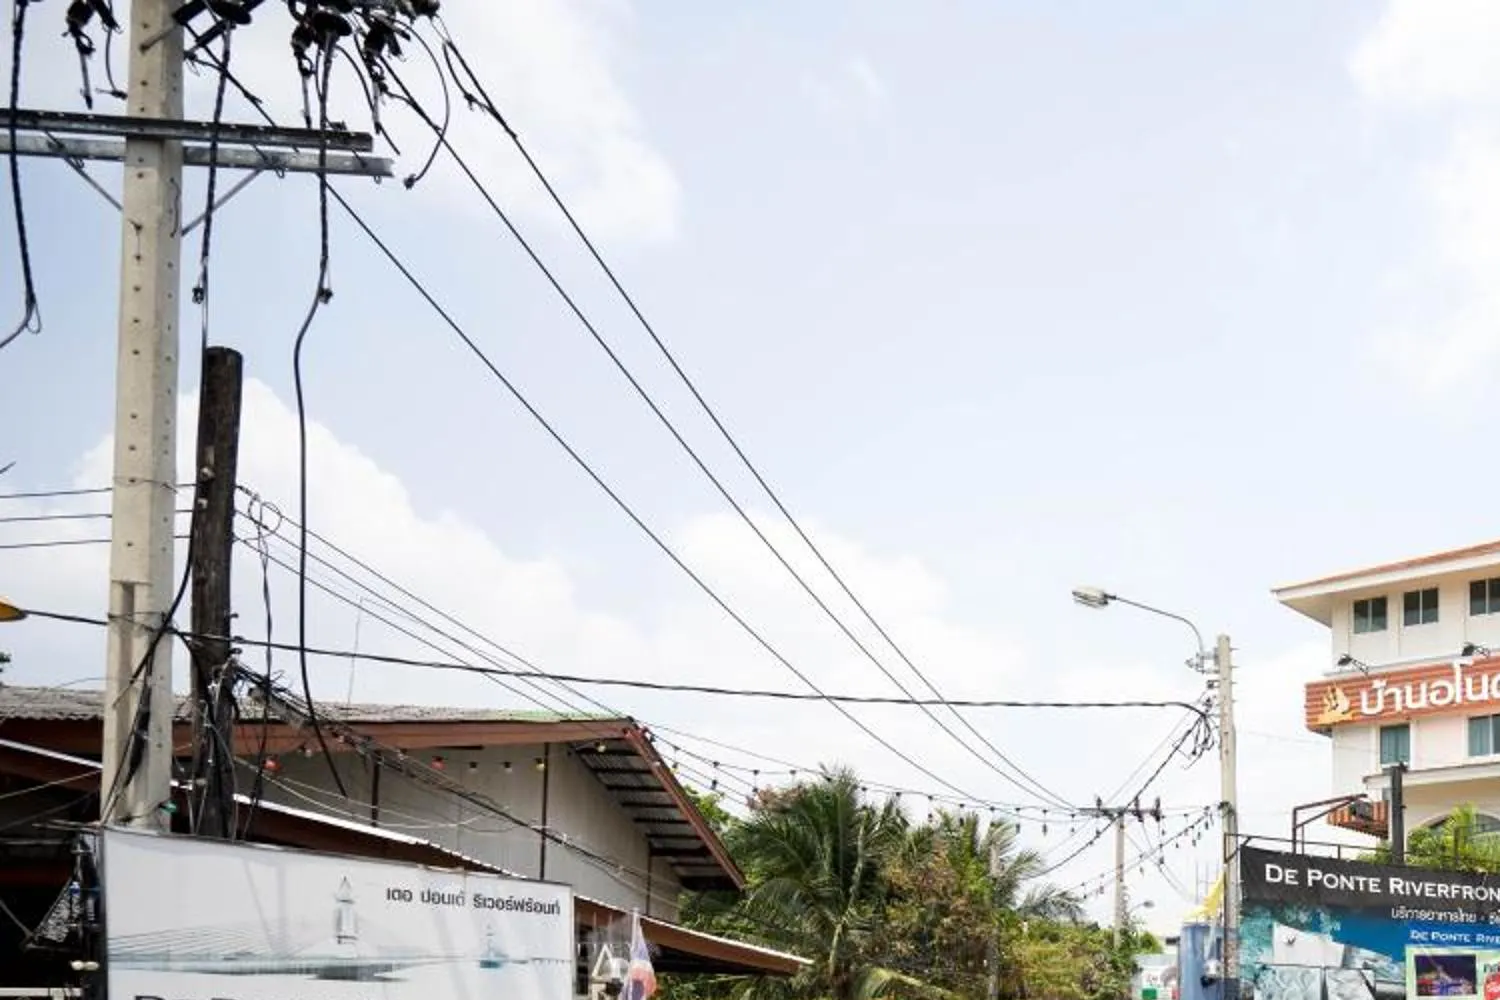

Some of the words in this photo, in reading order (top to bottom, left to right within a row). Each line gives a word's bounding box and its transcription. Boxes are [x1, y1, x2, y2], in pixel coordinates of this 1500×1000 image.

[1265, 863, 1298, 885] DE
[1307, 868, 1381, 893] PONTE
[1431, 930, 1470, 943] PONTE
